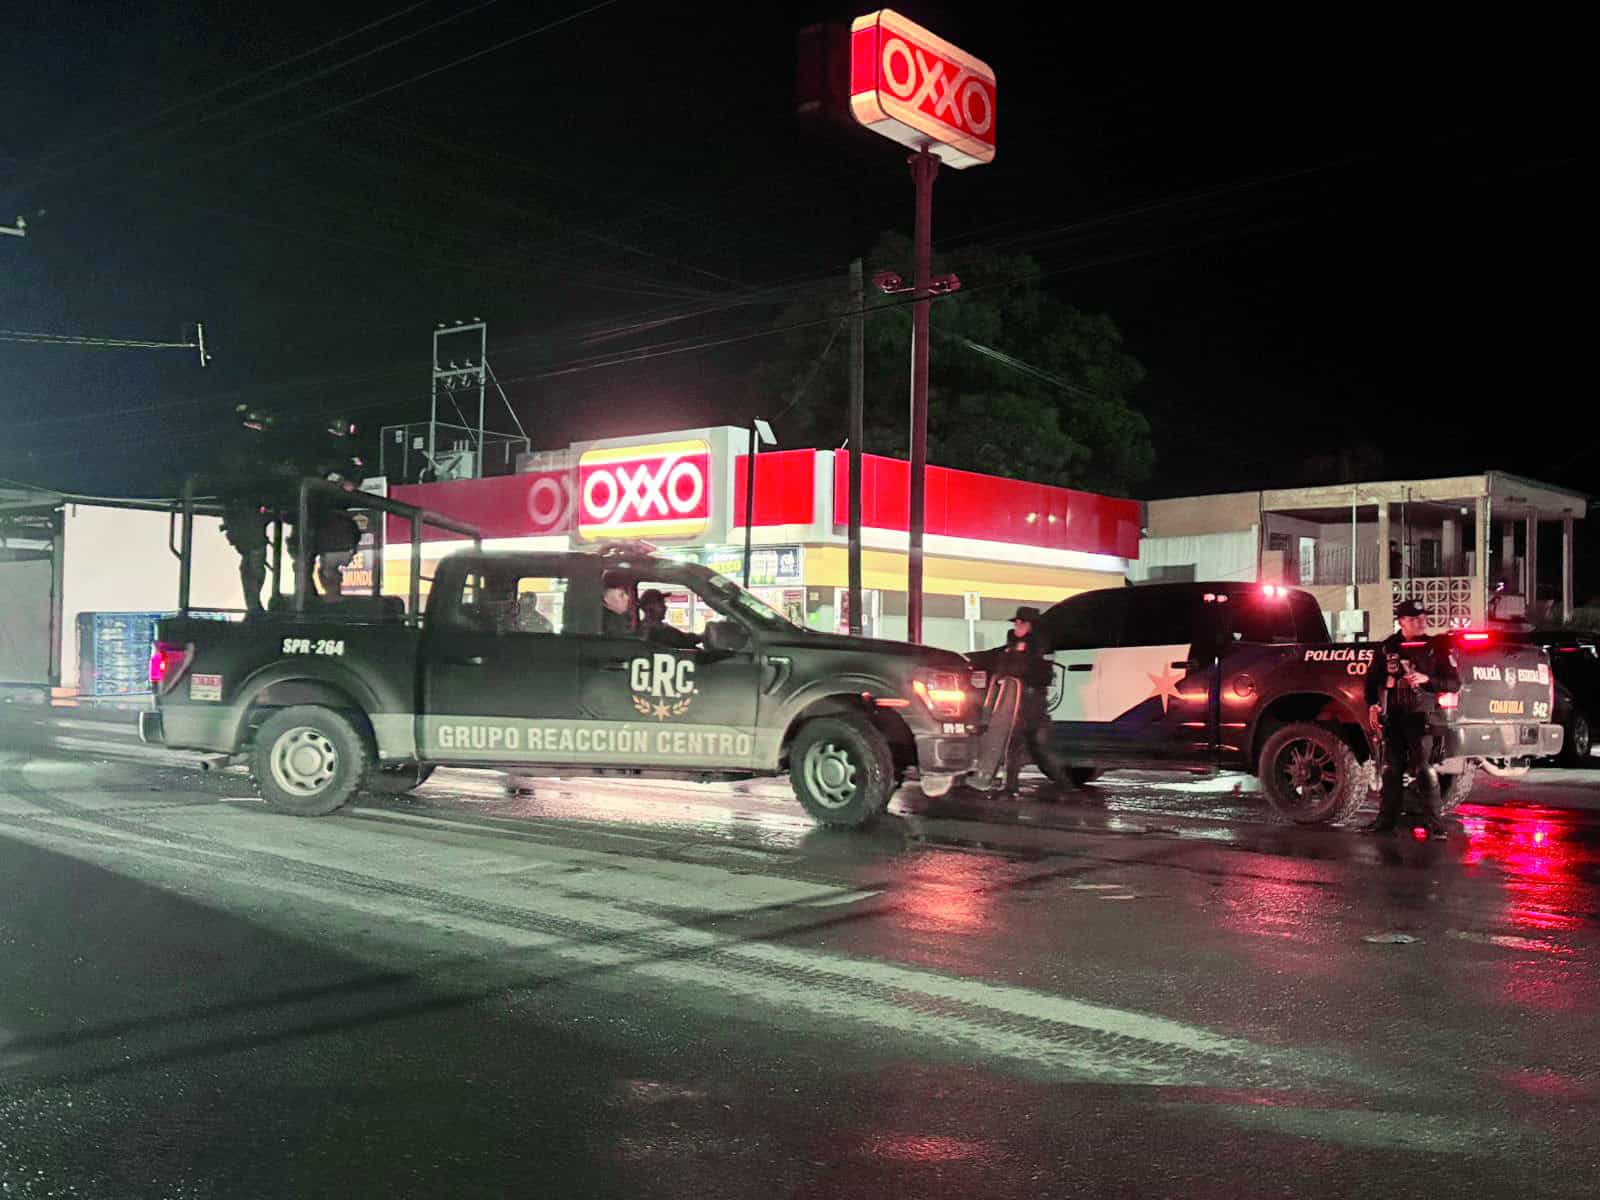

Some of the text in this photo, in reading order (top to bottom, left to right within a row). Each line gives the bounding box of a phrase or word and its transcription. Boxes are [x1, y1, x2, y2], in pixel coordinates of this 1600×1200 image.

[883, 38, 992, 135] OXXO
[584, 458, 703, 524] OXXO
[283, 638, 344, 656] SPR-264
[1304, 648, 1356, 662] POLICÍA
[1473, 665, 1502, 681] POLICÍA
[438, 725, 750, 755] GRUPO REACCIÓN CENTRO
